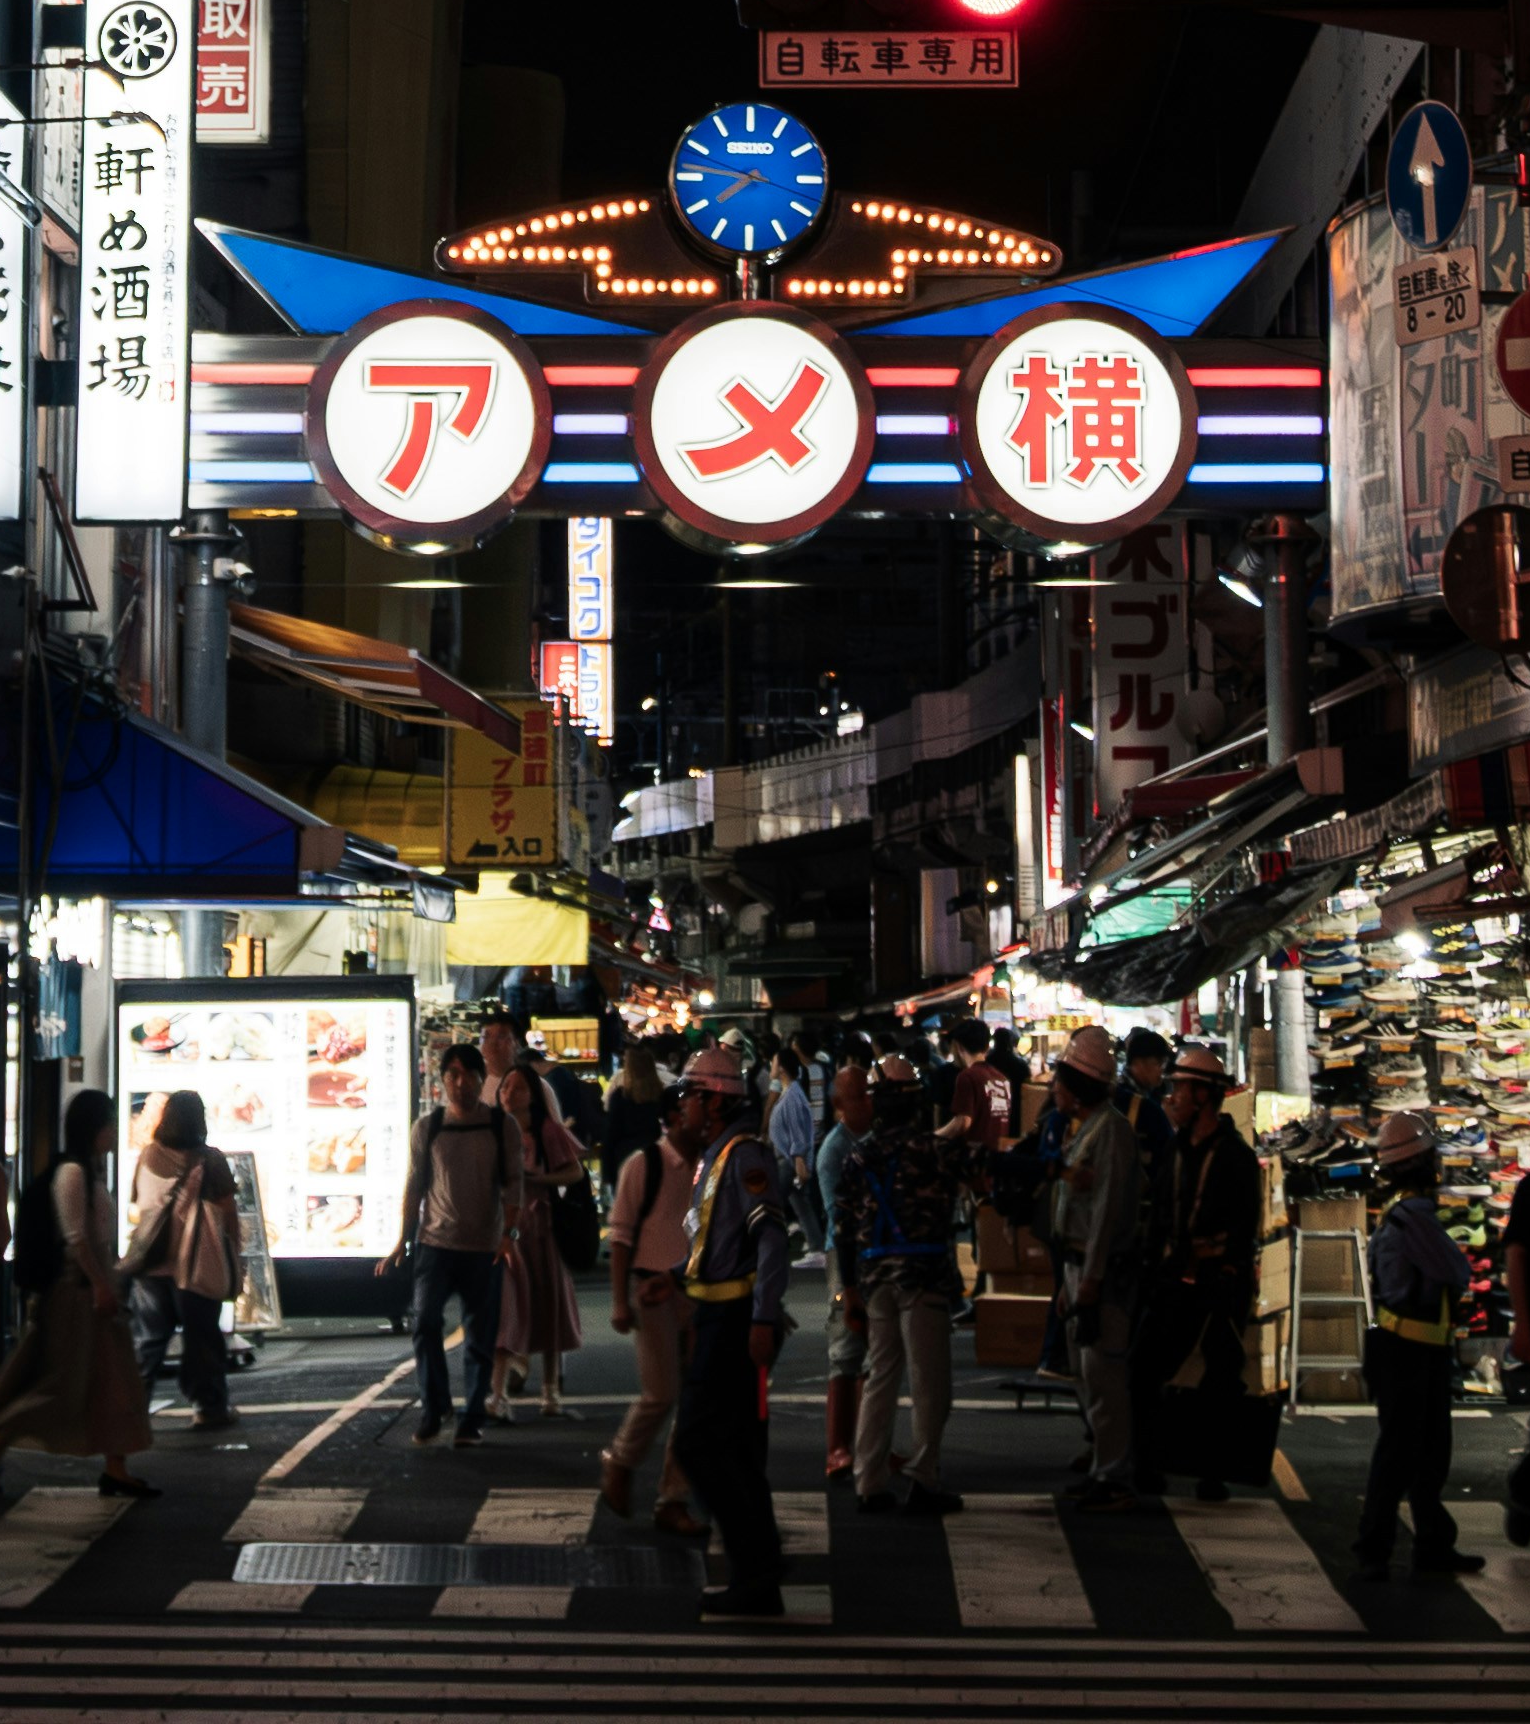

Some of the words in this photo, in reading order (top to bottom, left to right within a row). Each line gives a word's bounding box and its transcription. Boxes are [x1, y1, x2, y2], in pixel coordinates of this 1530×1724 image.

[776, 37, 1005, 76] 自転車専用
[198, 62, 247, 109] 売
[726, 141, 774, 156] SEIKO
[86, 142, 155, 403] 軒め酒場
[1397, 259, 1472, 304] 自転車を除く
[1405, 306, 1418, 333] 8
[1444, 293, 1467, 324] 20
[364, 350, 1148, 500] アメ横
[502, 837, 542, 856] 入口
